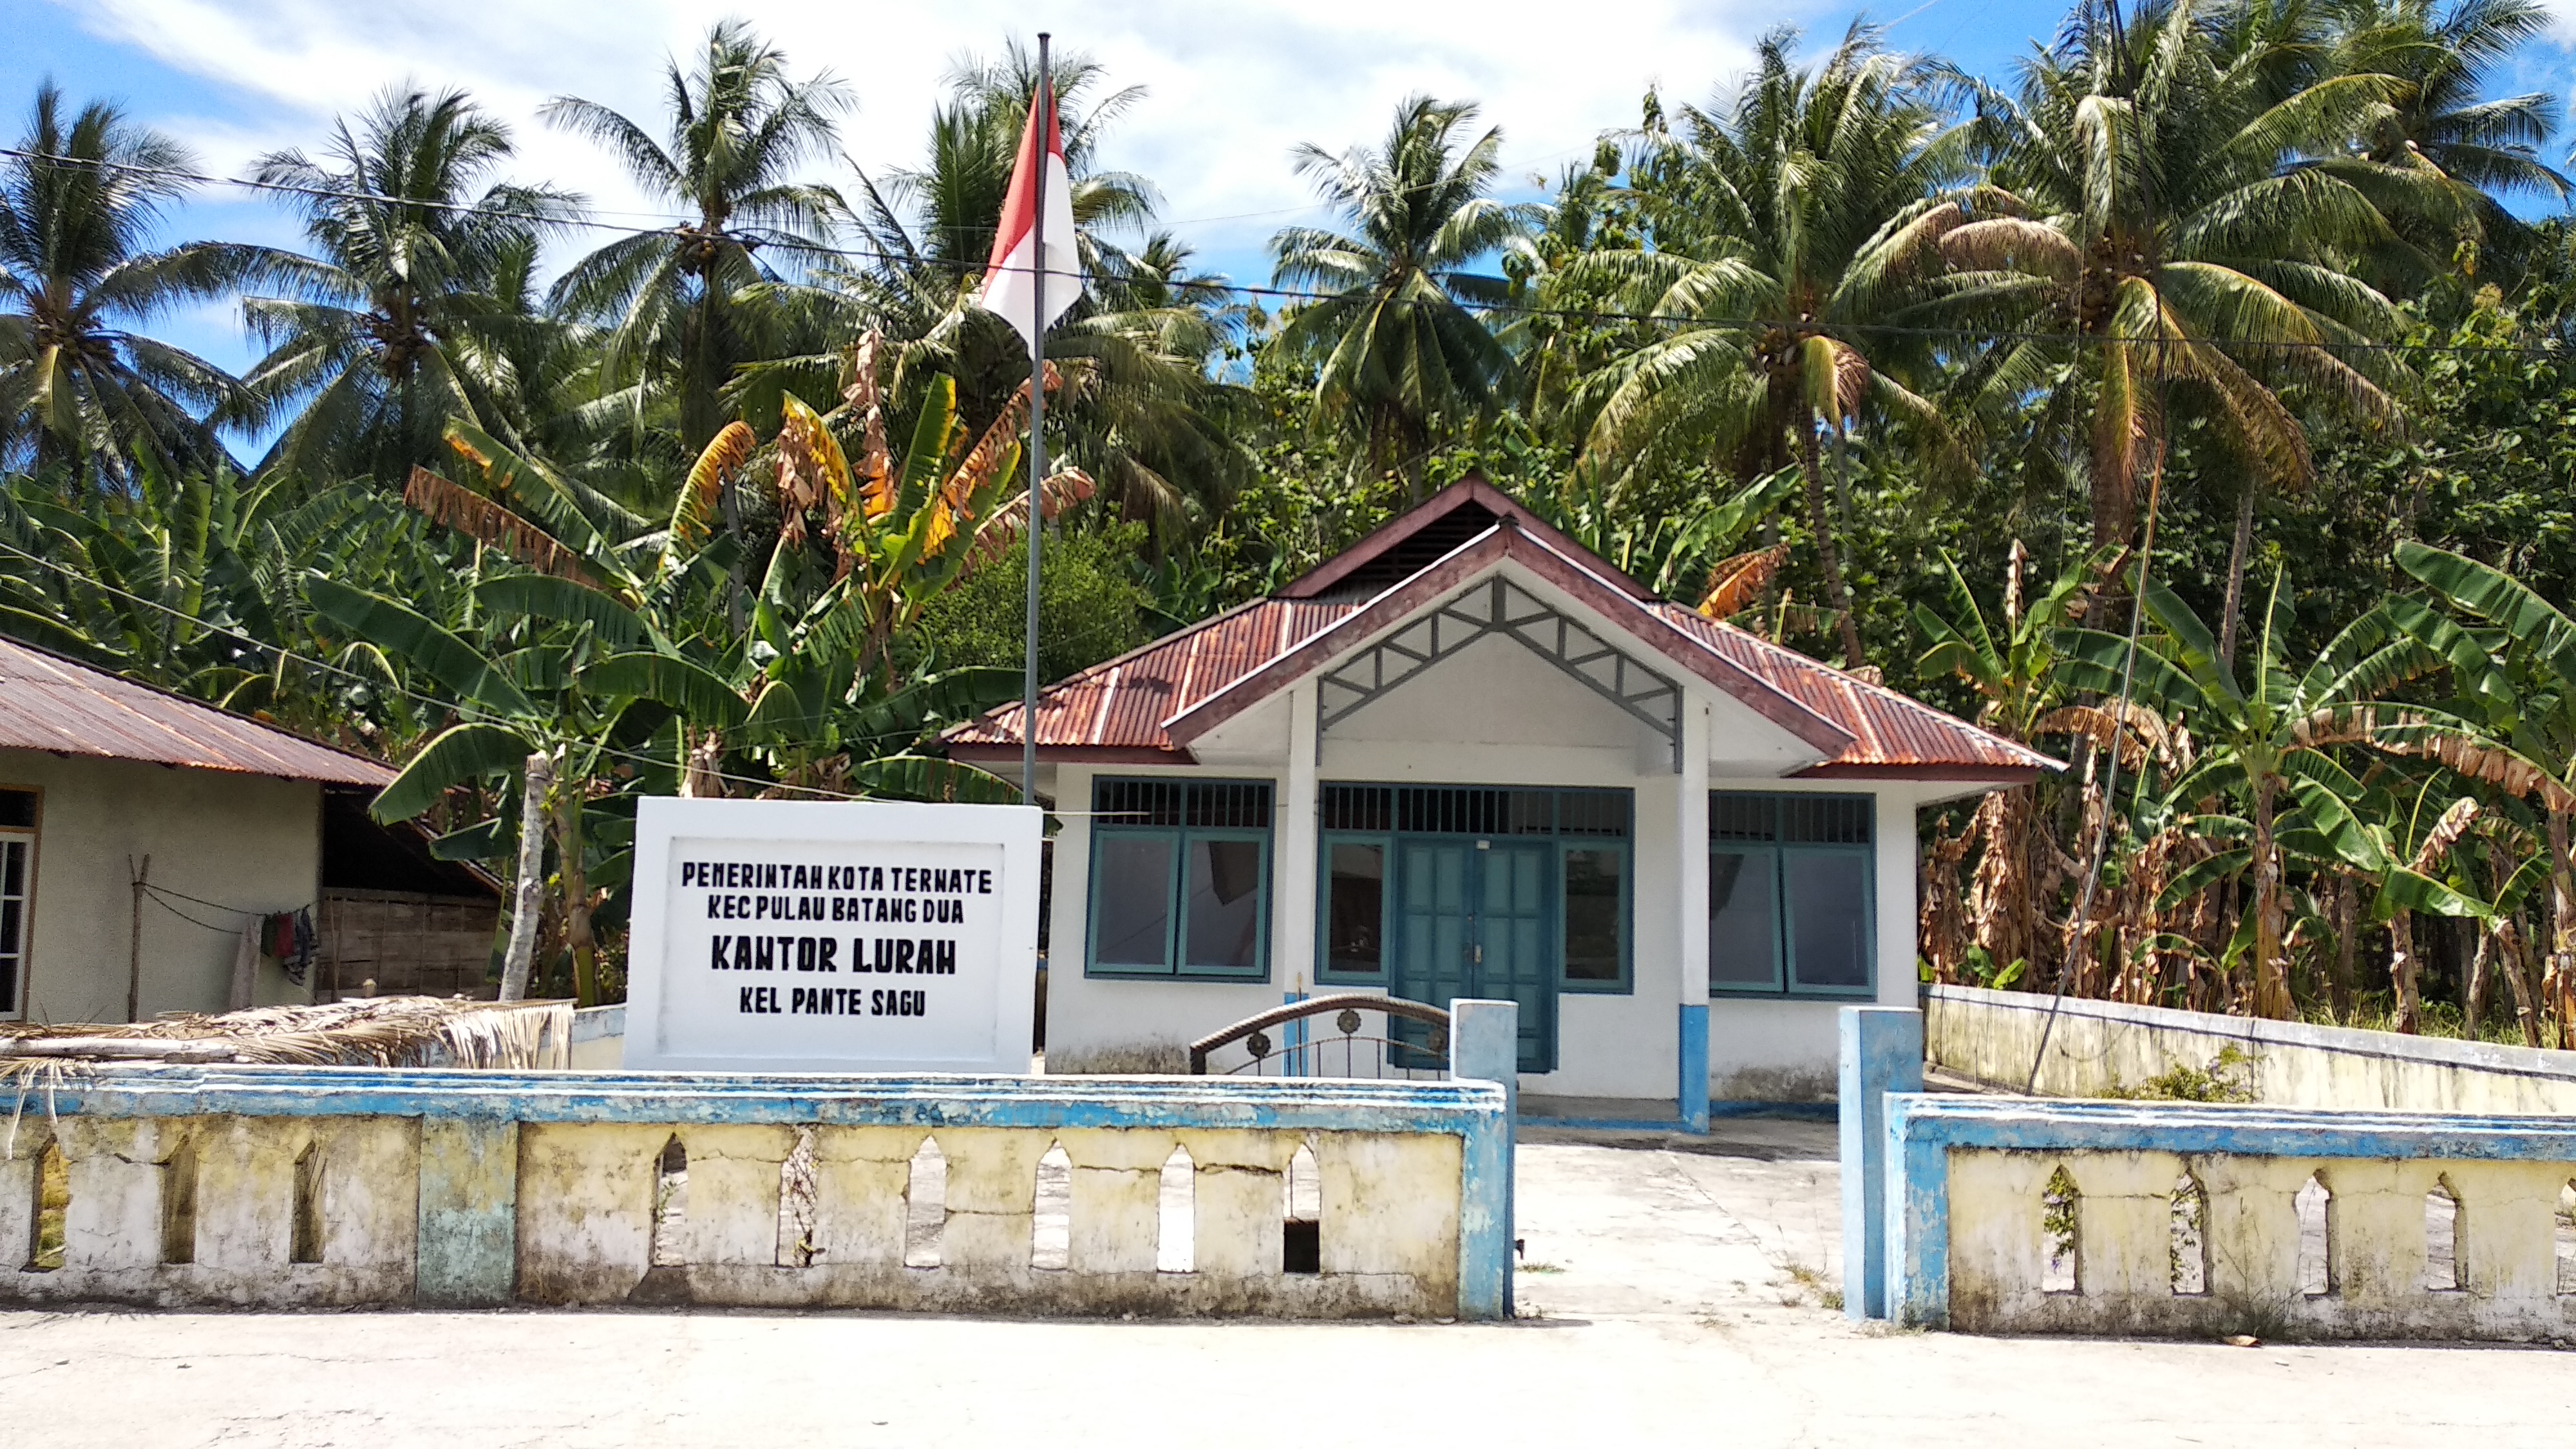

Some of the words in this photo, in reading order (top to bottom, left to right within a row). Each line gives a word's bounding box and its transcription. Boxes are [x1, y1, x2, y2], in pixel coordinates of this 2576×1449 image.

[682, 862, 823, 889] PEMERINTAH
[828, 866, 884, 891] KOTA
[891, 867, 992, 894] TERNATE
[707, 895, 750, 919] KEC
[755, 895, 825, 921] PULAU
[832, 897, 916, 923] BATANG
[923, 898, 964, 924] DUA
[711, 935, 837, 972] KANTOR
[852, 938, 956, 975] LURAH
[740, 986, 782, 1014] KEL
[791, 987, 862, 1016] PANTE
[871, 989, 926, 1017] SAGU
